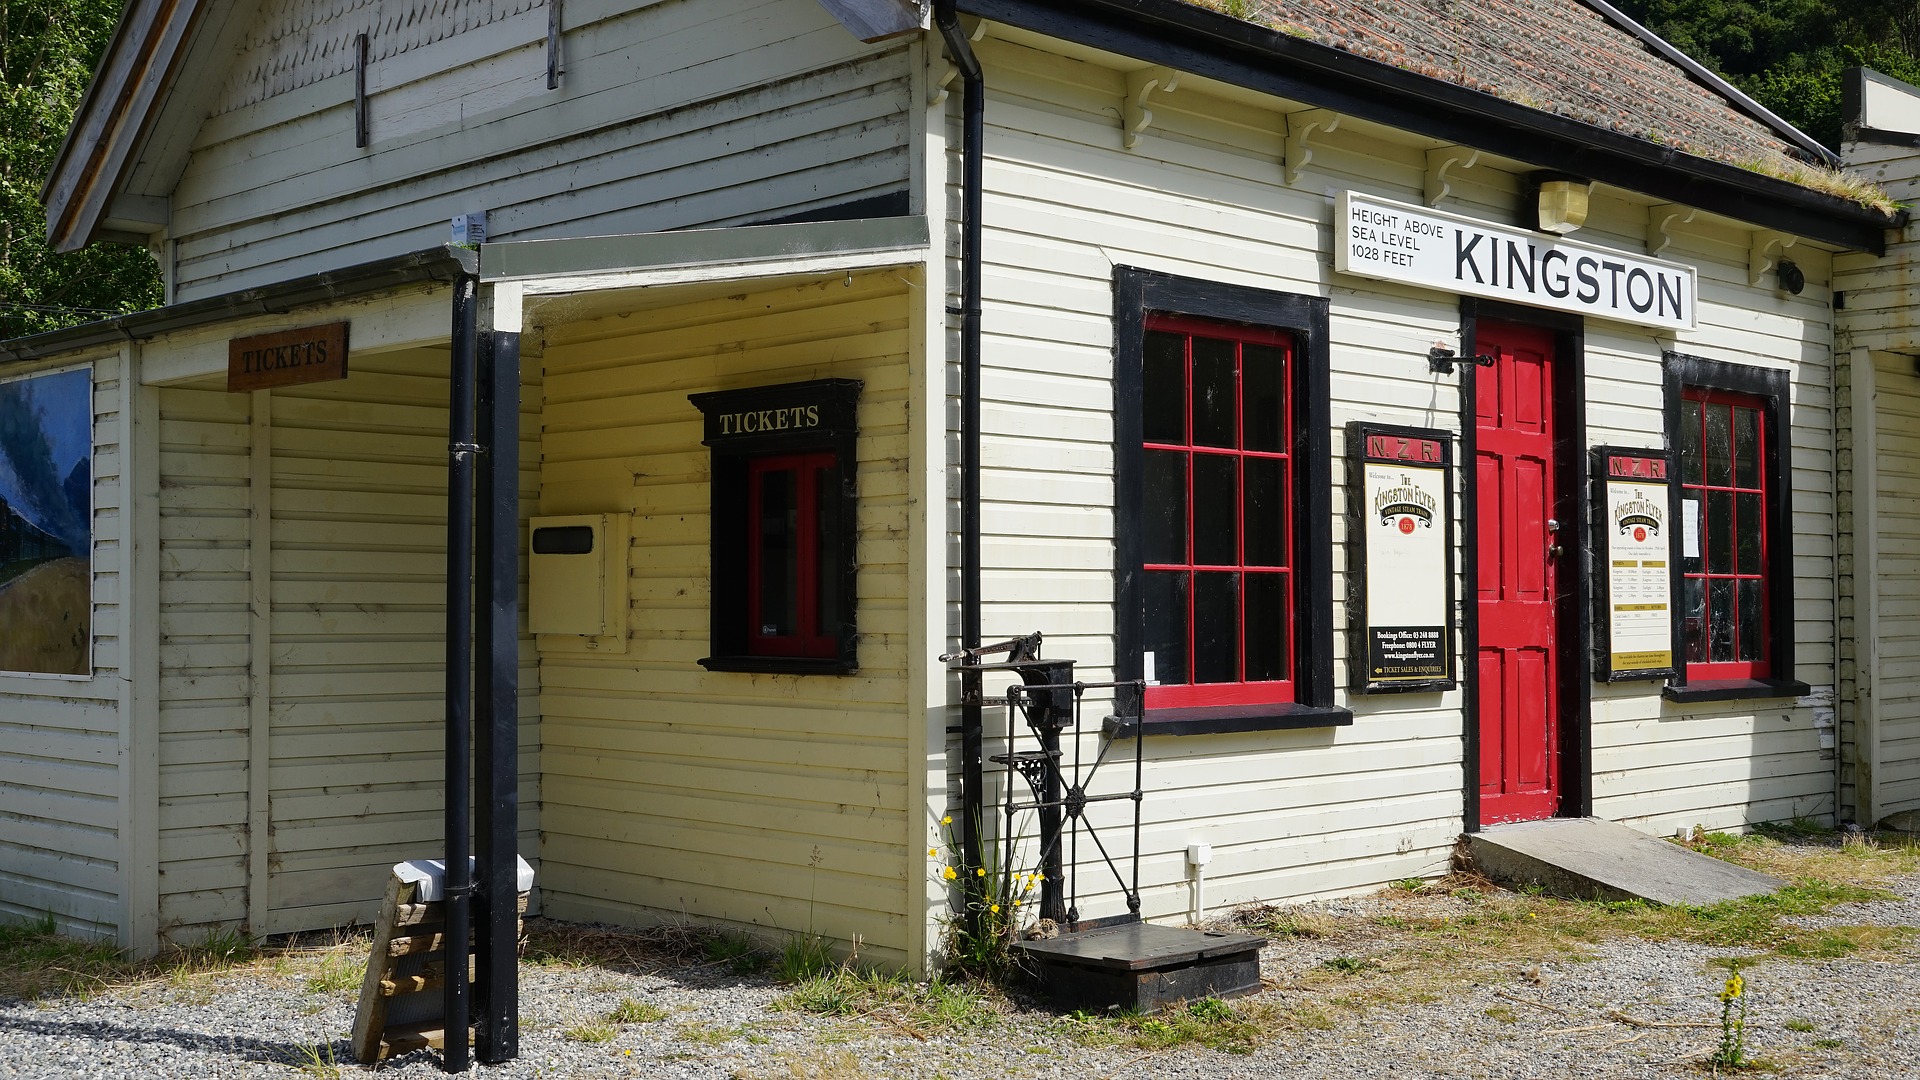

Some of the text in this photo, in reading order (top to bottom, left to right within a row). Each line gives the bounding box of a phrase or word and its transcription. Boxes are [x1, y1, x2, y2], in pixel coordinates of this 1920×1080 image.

[1352, 207, 1444, 239] HEIGHT ABOVE
[1352, 226, 1420, 251] SEA LEVEL
[1352, 244, 1414, 268] 1028 FEET
[1454, 229, 1683, 320] KINGSTON
[243, 340, 327, 374] TICKETS
[720, 404, 819, 435] TICKETS
[1374, 485, 1437, 515] KINGSTON FLYER
[1376, 631, 1398, 641] Bookings
[1421, 640, 1436, 649] FLYER
[1401, 665, 1413, 673] SALES
